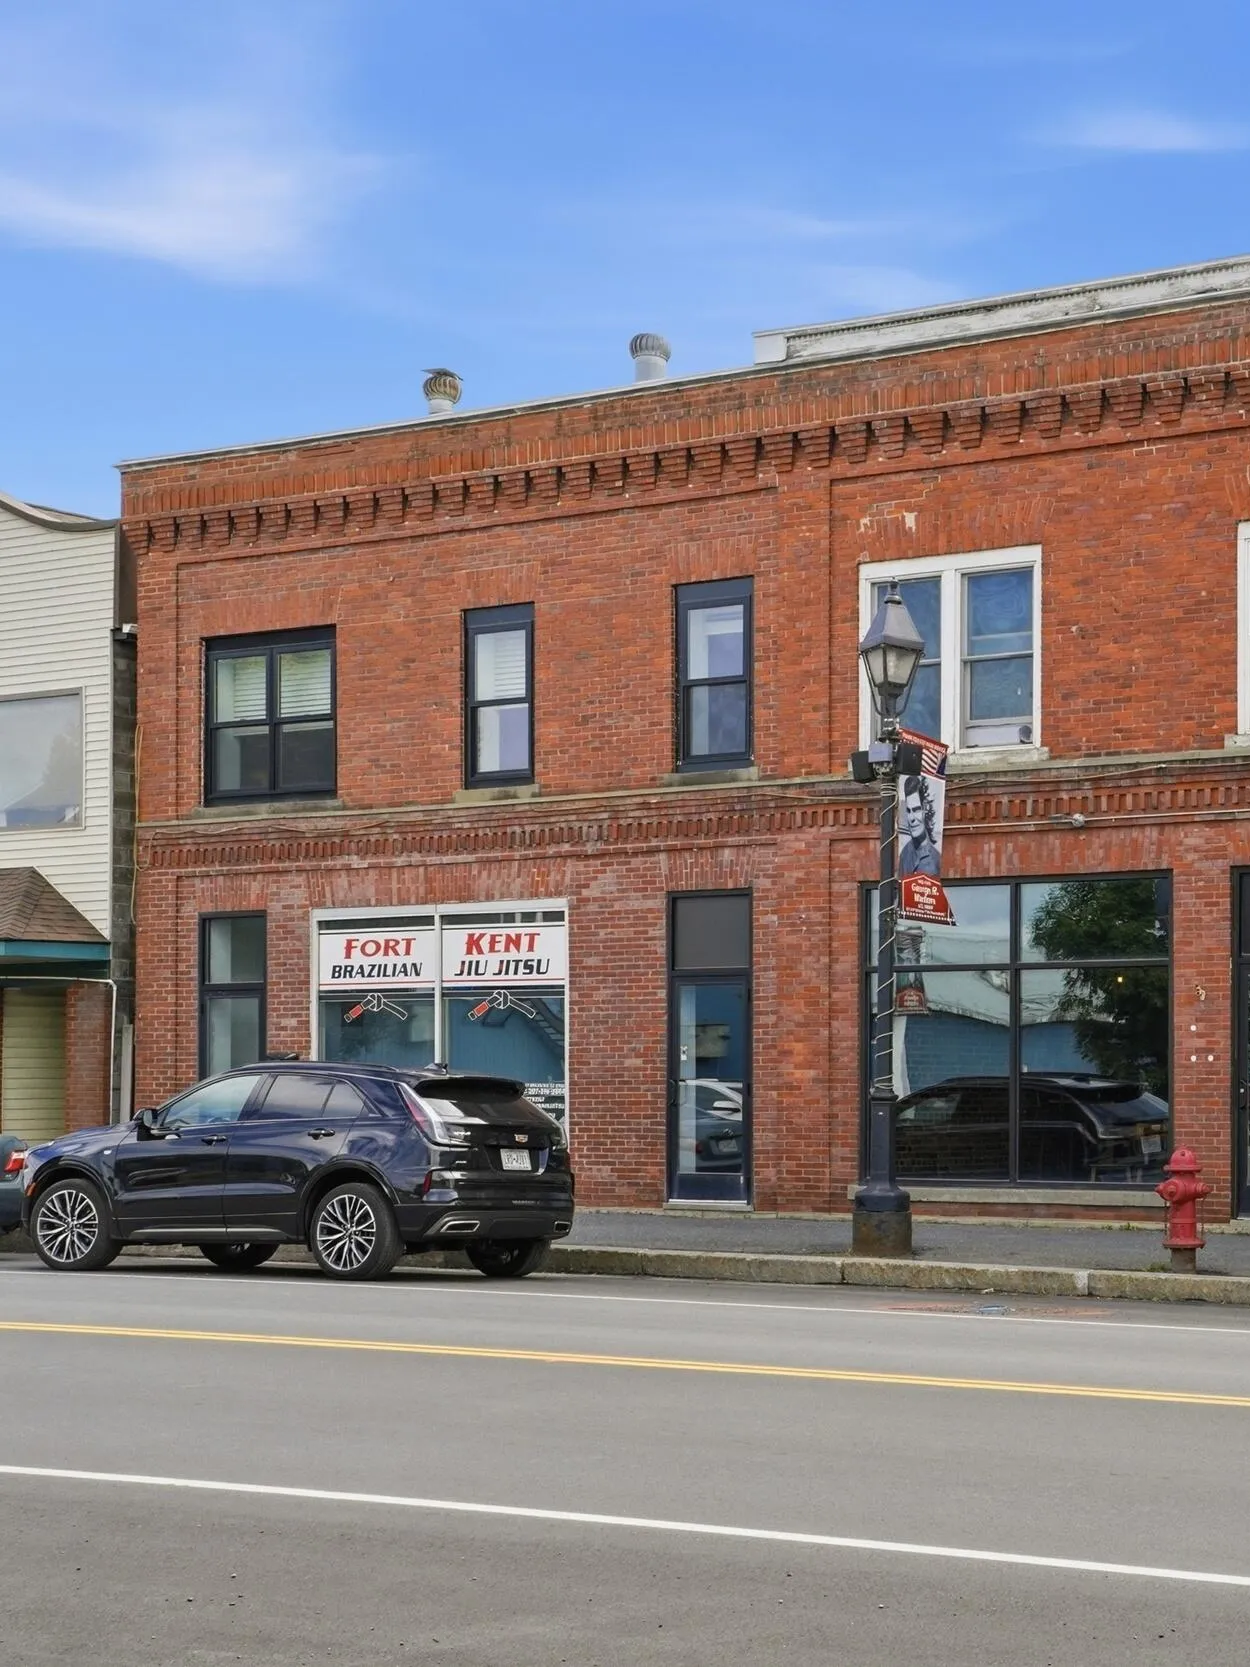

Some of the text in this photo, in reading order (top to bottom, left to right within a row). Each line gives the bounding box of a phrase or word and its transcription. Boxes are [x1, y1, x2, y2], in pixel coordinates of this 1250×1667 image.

[344, 933, 540, 959] FORT KENT
[331, 958, 550, 979] BRAZILIAN JIU JITSU
